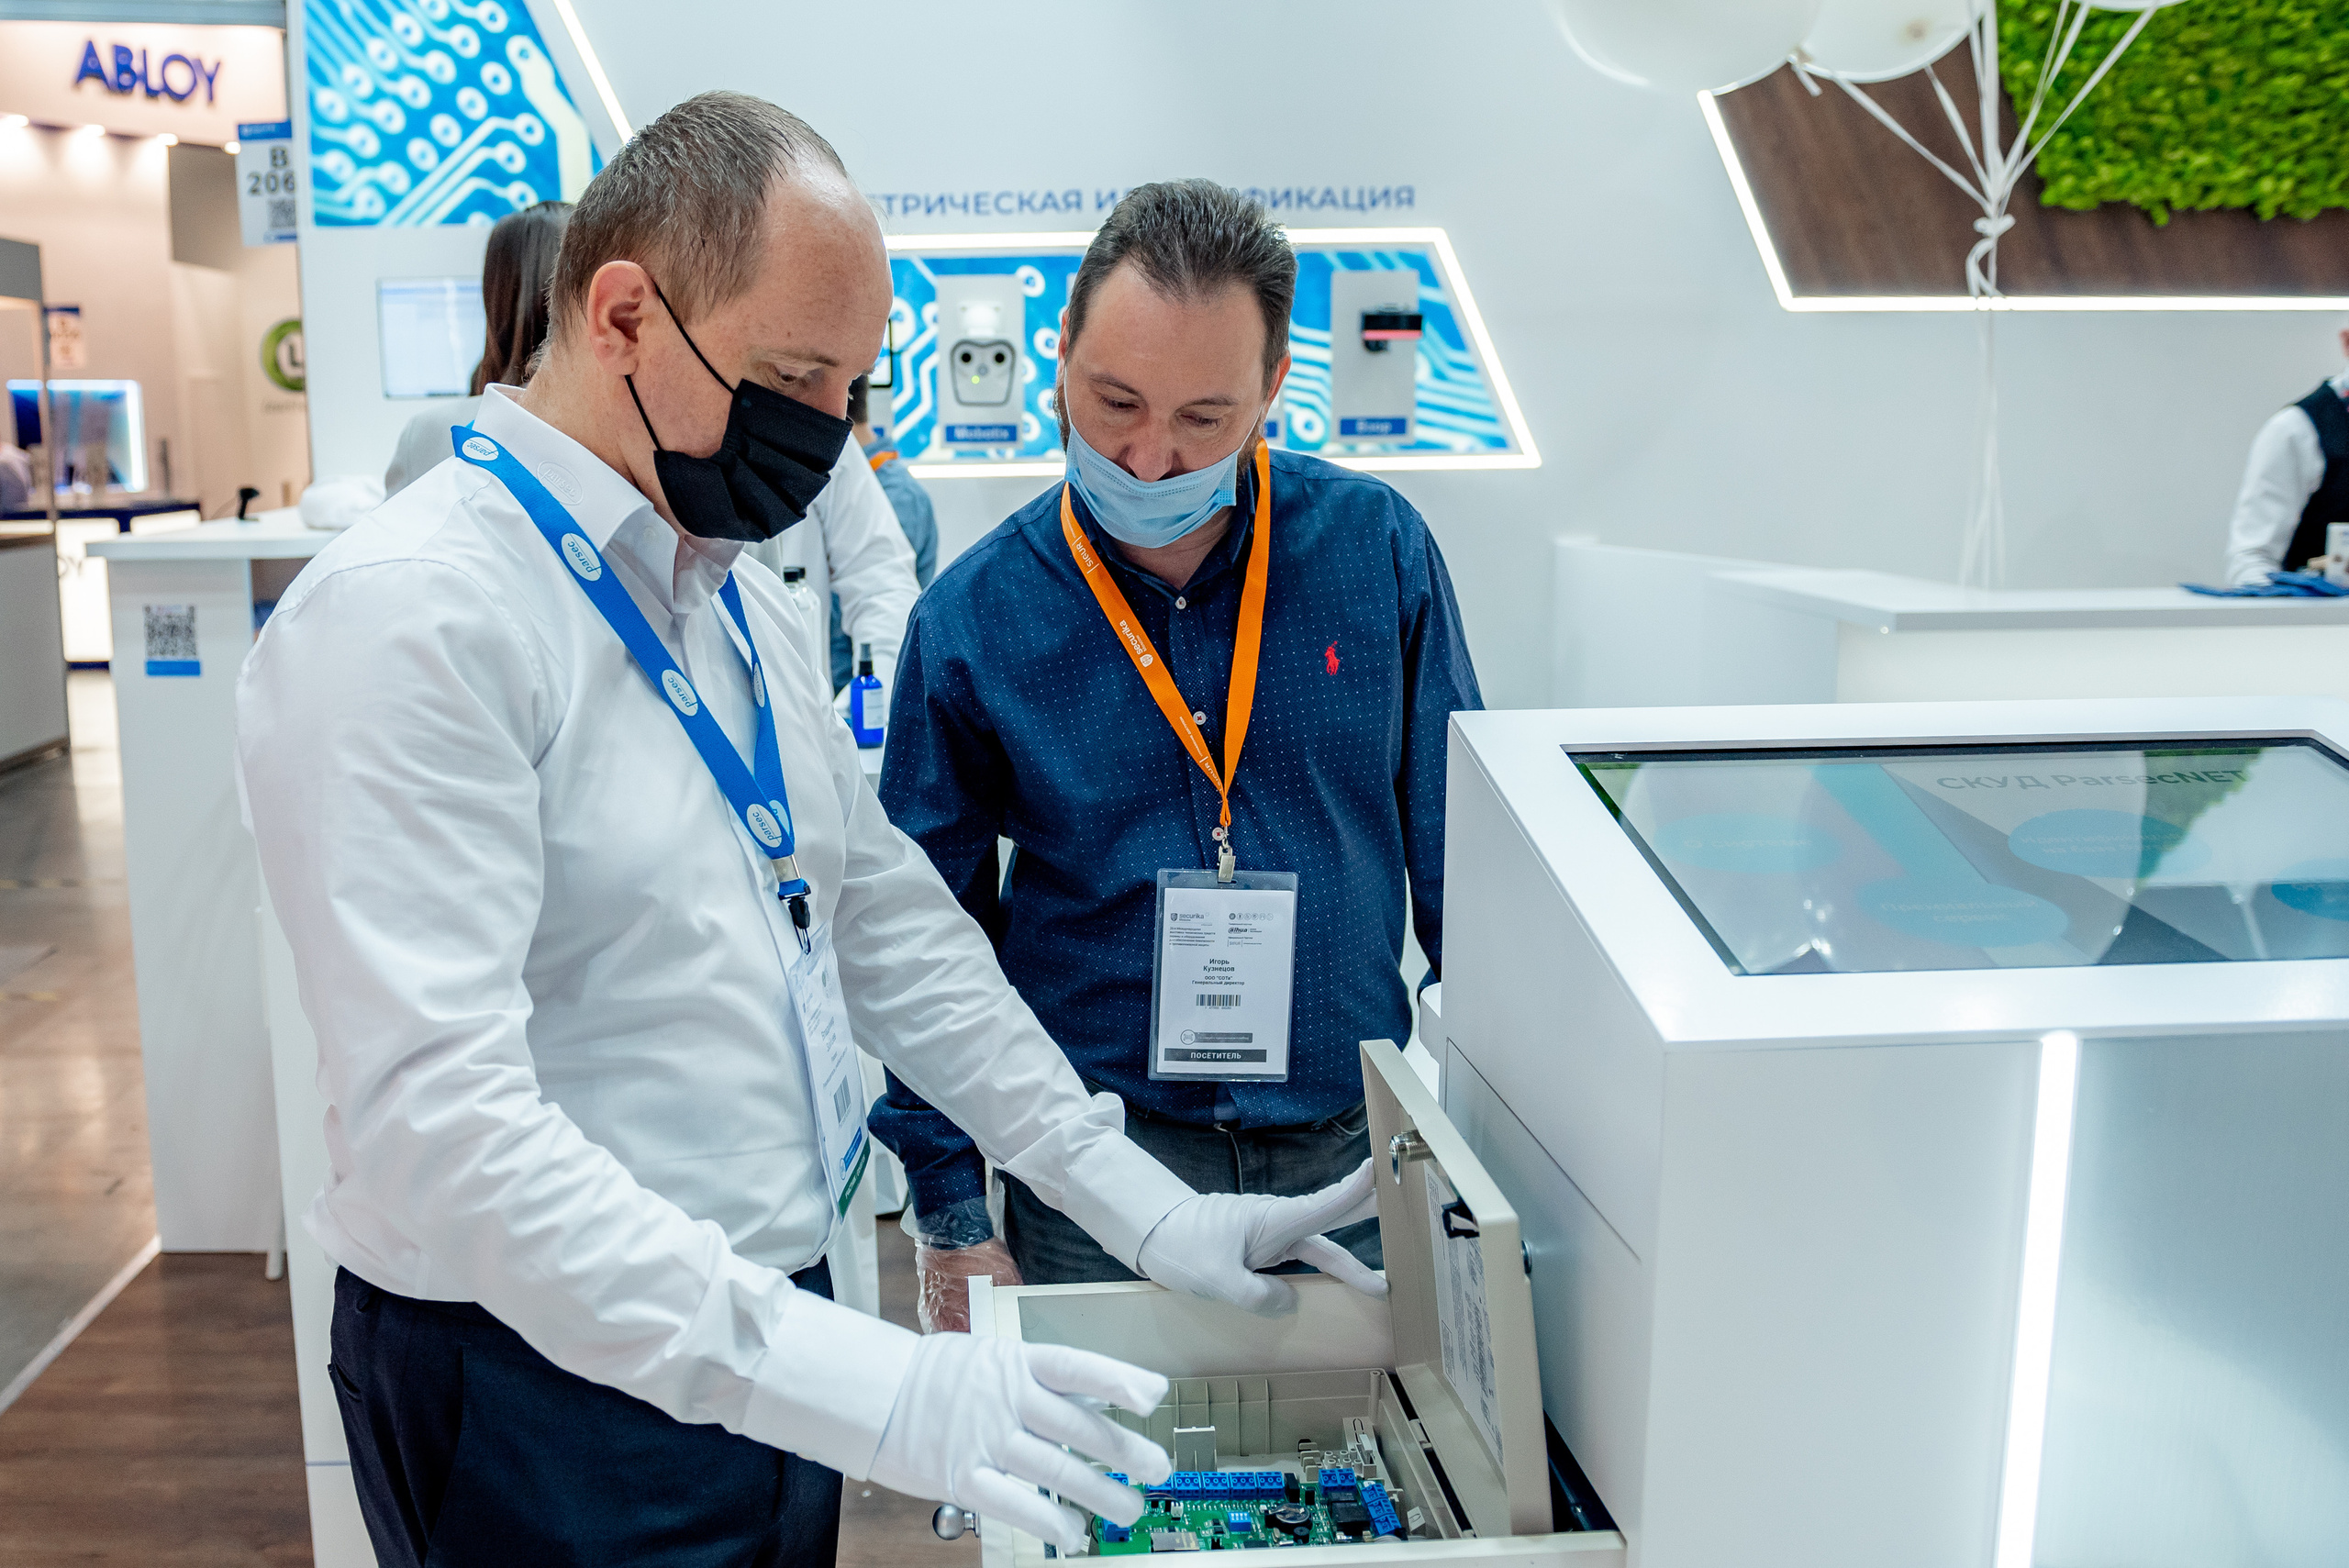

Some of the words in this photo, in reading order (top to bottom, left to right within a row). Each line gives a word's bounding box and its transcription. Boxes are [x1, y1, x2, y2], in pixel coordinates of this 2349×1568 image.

[74, 39, 221, 104] ABLOY
[247, 171, 295, 195] 206
[865, 188, 1084, 216] ТРИЧЕСКАЯ
[466, 441, 498, 457] parsec
[541, 468, 576, 498] parsec
[567, 541, 602, 573] parsec
[1075, 541, 1094, 567] SIGUR
[1119, 619, 1143, 655] securika
[667, 676, 698, 707] parsec
[1936, 774, 2050, 790] СКУД
[2049, 770, 2249, 787] ParsecNET
[752, 811, 783, 840] parsec
[1209, 958, 1230, 966] Игорь
[1190, 1051, 1241, 1060] ПОСЕТИТЕЛЬ
